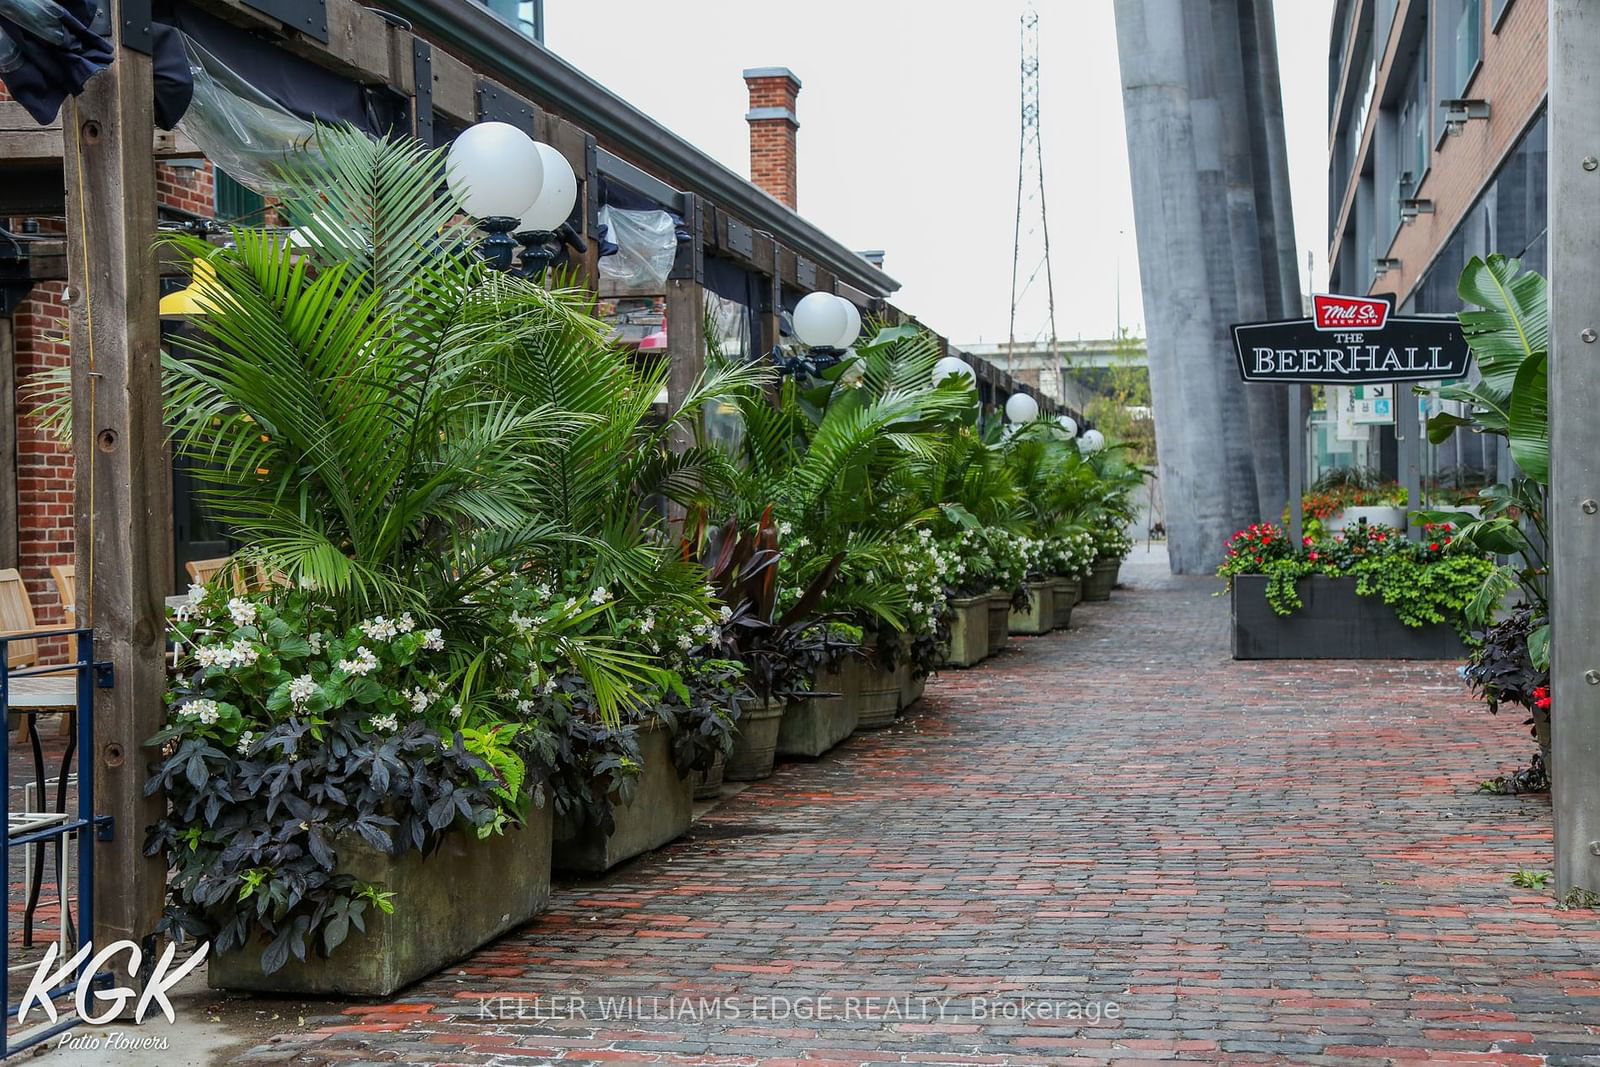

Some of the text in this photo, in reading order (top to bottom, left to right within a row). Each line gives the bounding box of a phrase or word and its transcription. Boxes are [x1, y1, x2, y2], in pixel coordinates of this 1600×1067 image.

[1322, 304, 1378, 319] Mill St.
[1334, 333, 1364, 344] THE
[1252, 345, 1453, 374] BEERHALL
